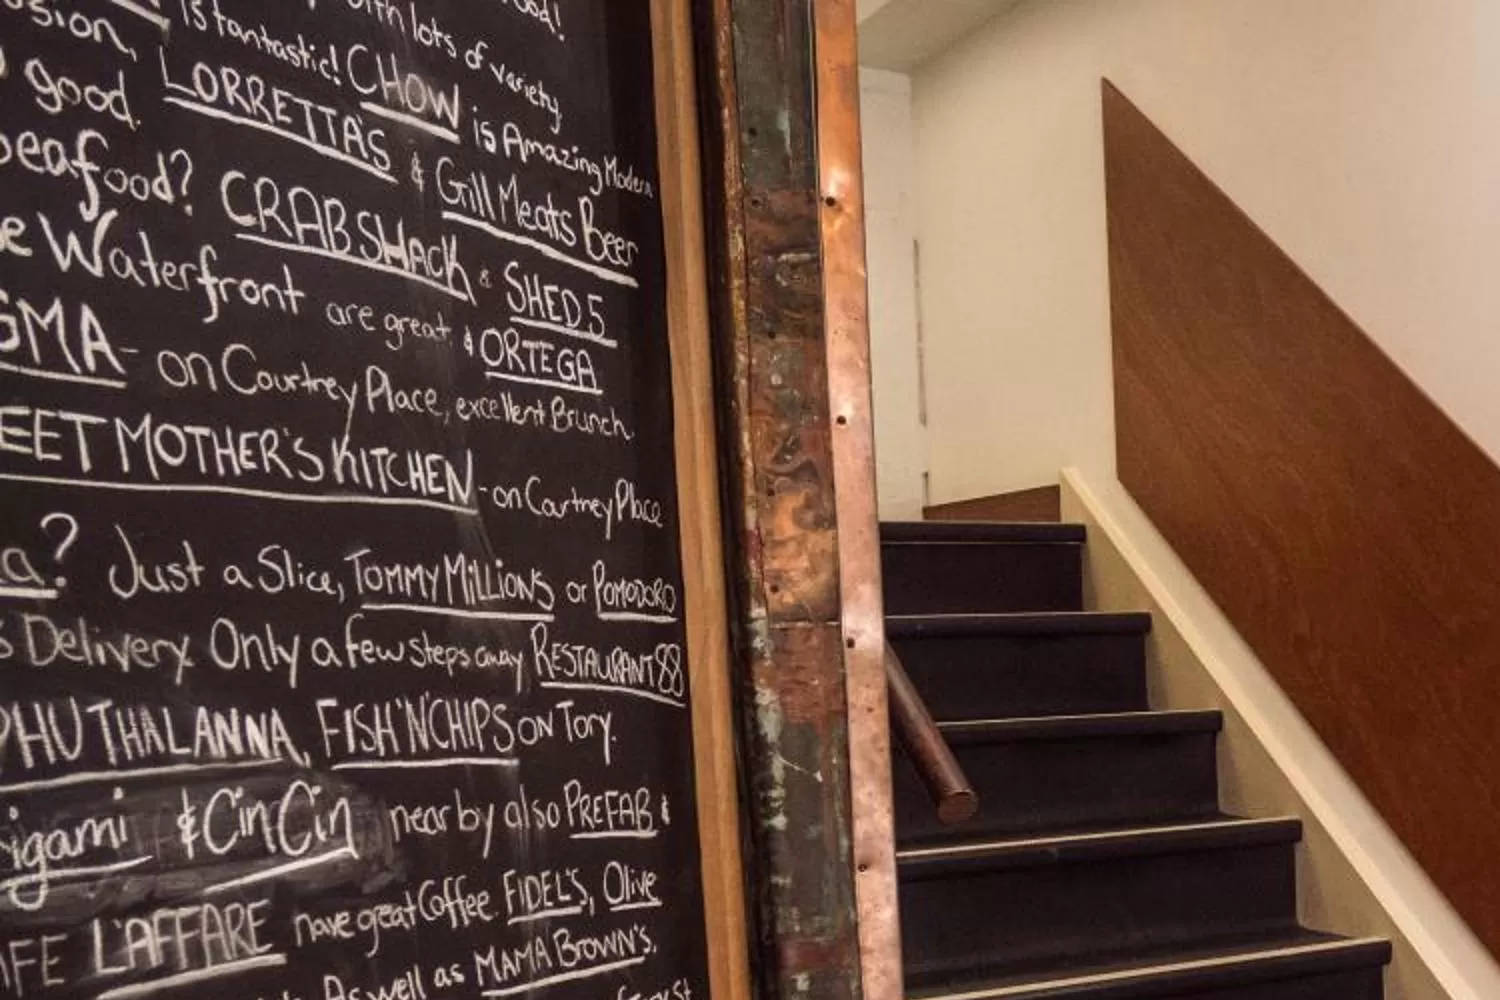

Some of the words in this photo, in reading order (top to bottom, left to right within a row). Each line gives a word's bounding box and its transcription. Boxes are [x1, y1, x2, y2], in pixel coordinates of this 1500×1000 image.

[410, 0, 457, 57] lots
[464, 40, 488, 70] of
[489, 62, 562, 135] variety
[159, 45, 392, 171] LORRETTA'S
[498, 173, 577, 247] Meats
[577, 196, 640, 266] Beer
[347, 43, 460, 129] CHOW
[472, 104, 498, 153] is
[503, 122, 604, 196] Amazing
[36, 210, 305, 323] Waterfront
[326, 302, 374, 332] are
[384, 311, 451, 351] great
[479, 328, 597, 391] ORTEGA
[504, 261, 582, 329] SHED
[587, 294, 606, 338] 5
[157, 350, 217, 392] on
[365, 365, 451, 427] Place,
[456, 392, 547, 426] excellent
[114, 412, 325, 482] MOTHER'S
[330, 436, 473, 502] KITCHEN
[493, 485, 523, 509] on
[615, 478, 663, 529] Place
[108, 523, 206, 599] Just
[223, 565, 254, 589] a
[257, 543, 346, 602] Slice,
[344, 549, 440, 603] TOMMY
[566, 580, 587, 603] or
[22, 612, 195, 686] Delivery
[209, 617, 300, 688] Only
[310, 637, 343, 668] a
[345, 613, 405, 669] few
[408, 631, 471, 677] steps
[474, 647, 524, 695] away
[655, 643, 686, 698] 88
[555, 700, 617, 766] Tory.
[177, 787, 200, 860] &
[504, 783, 561, 831] also
[564, 779, 652, 833] PREFAB
[357, 890, 417, 958] great
[603, 860, 658, 904] Olive
[433, 962, 465, 989] as
[473, 936, 552, 987] MAMA
